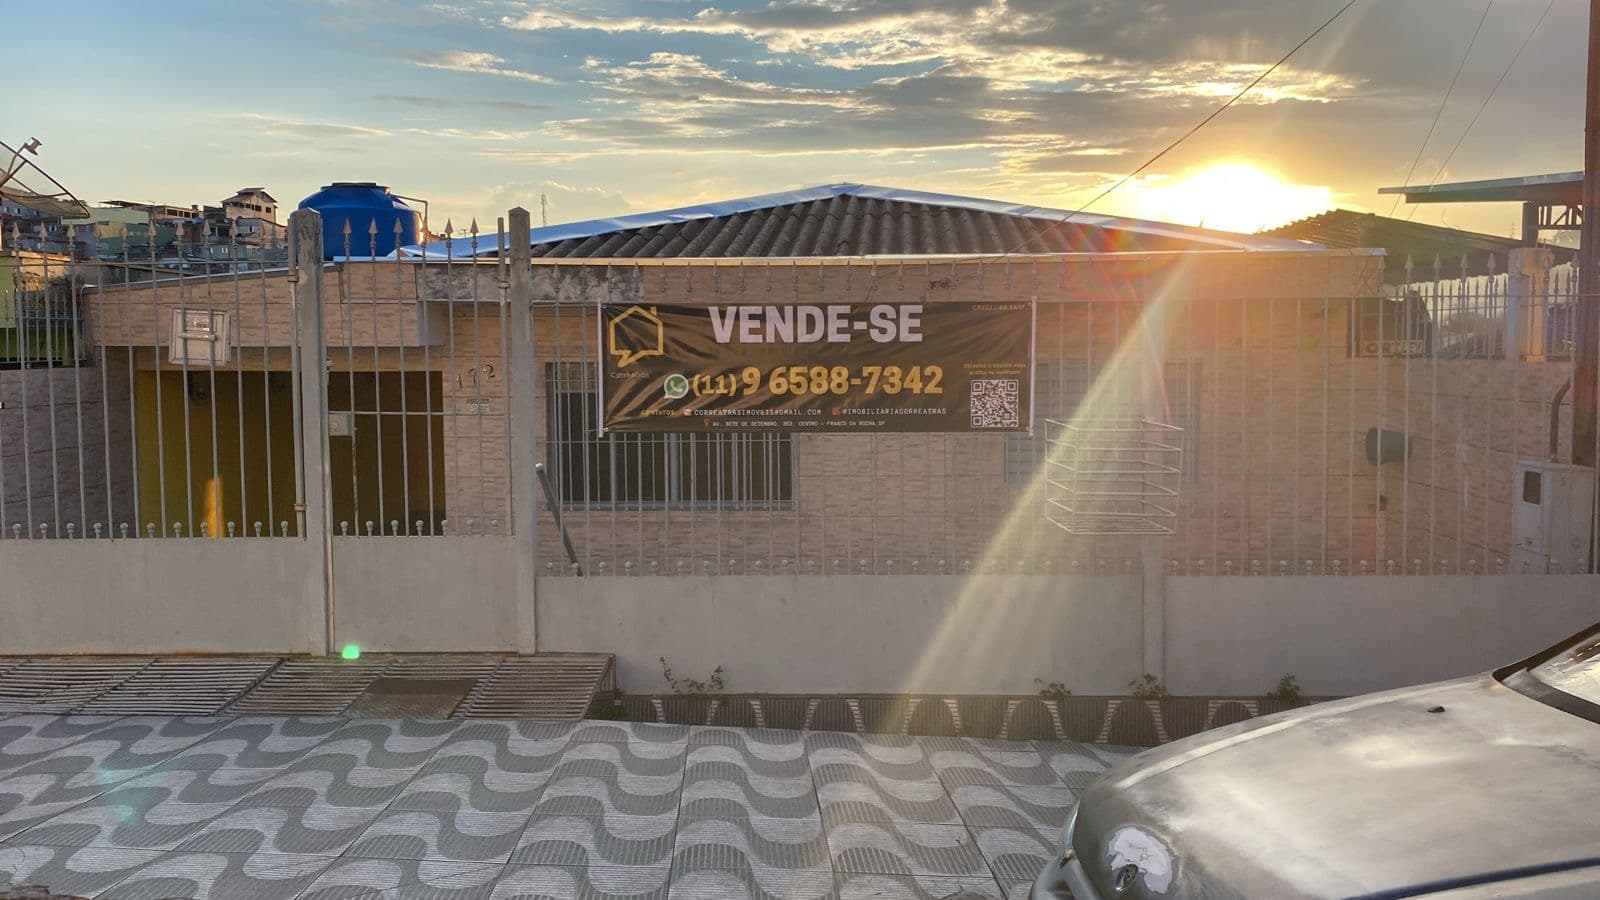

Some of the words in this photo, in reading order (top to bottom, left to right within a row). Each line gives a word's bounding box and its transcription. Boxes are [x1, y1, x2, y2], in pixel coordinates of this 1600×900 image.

[708, 304, 923, 343] VENDE-SE
[692, 374, 737, 396] (11)
[742, 366, 761, 395] 9
[768, 366, 943, 395] 6588-7342
